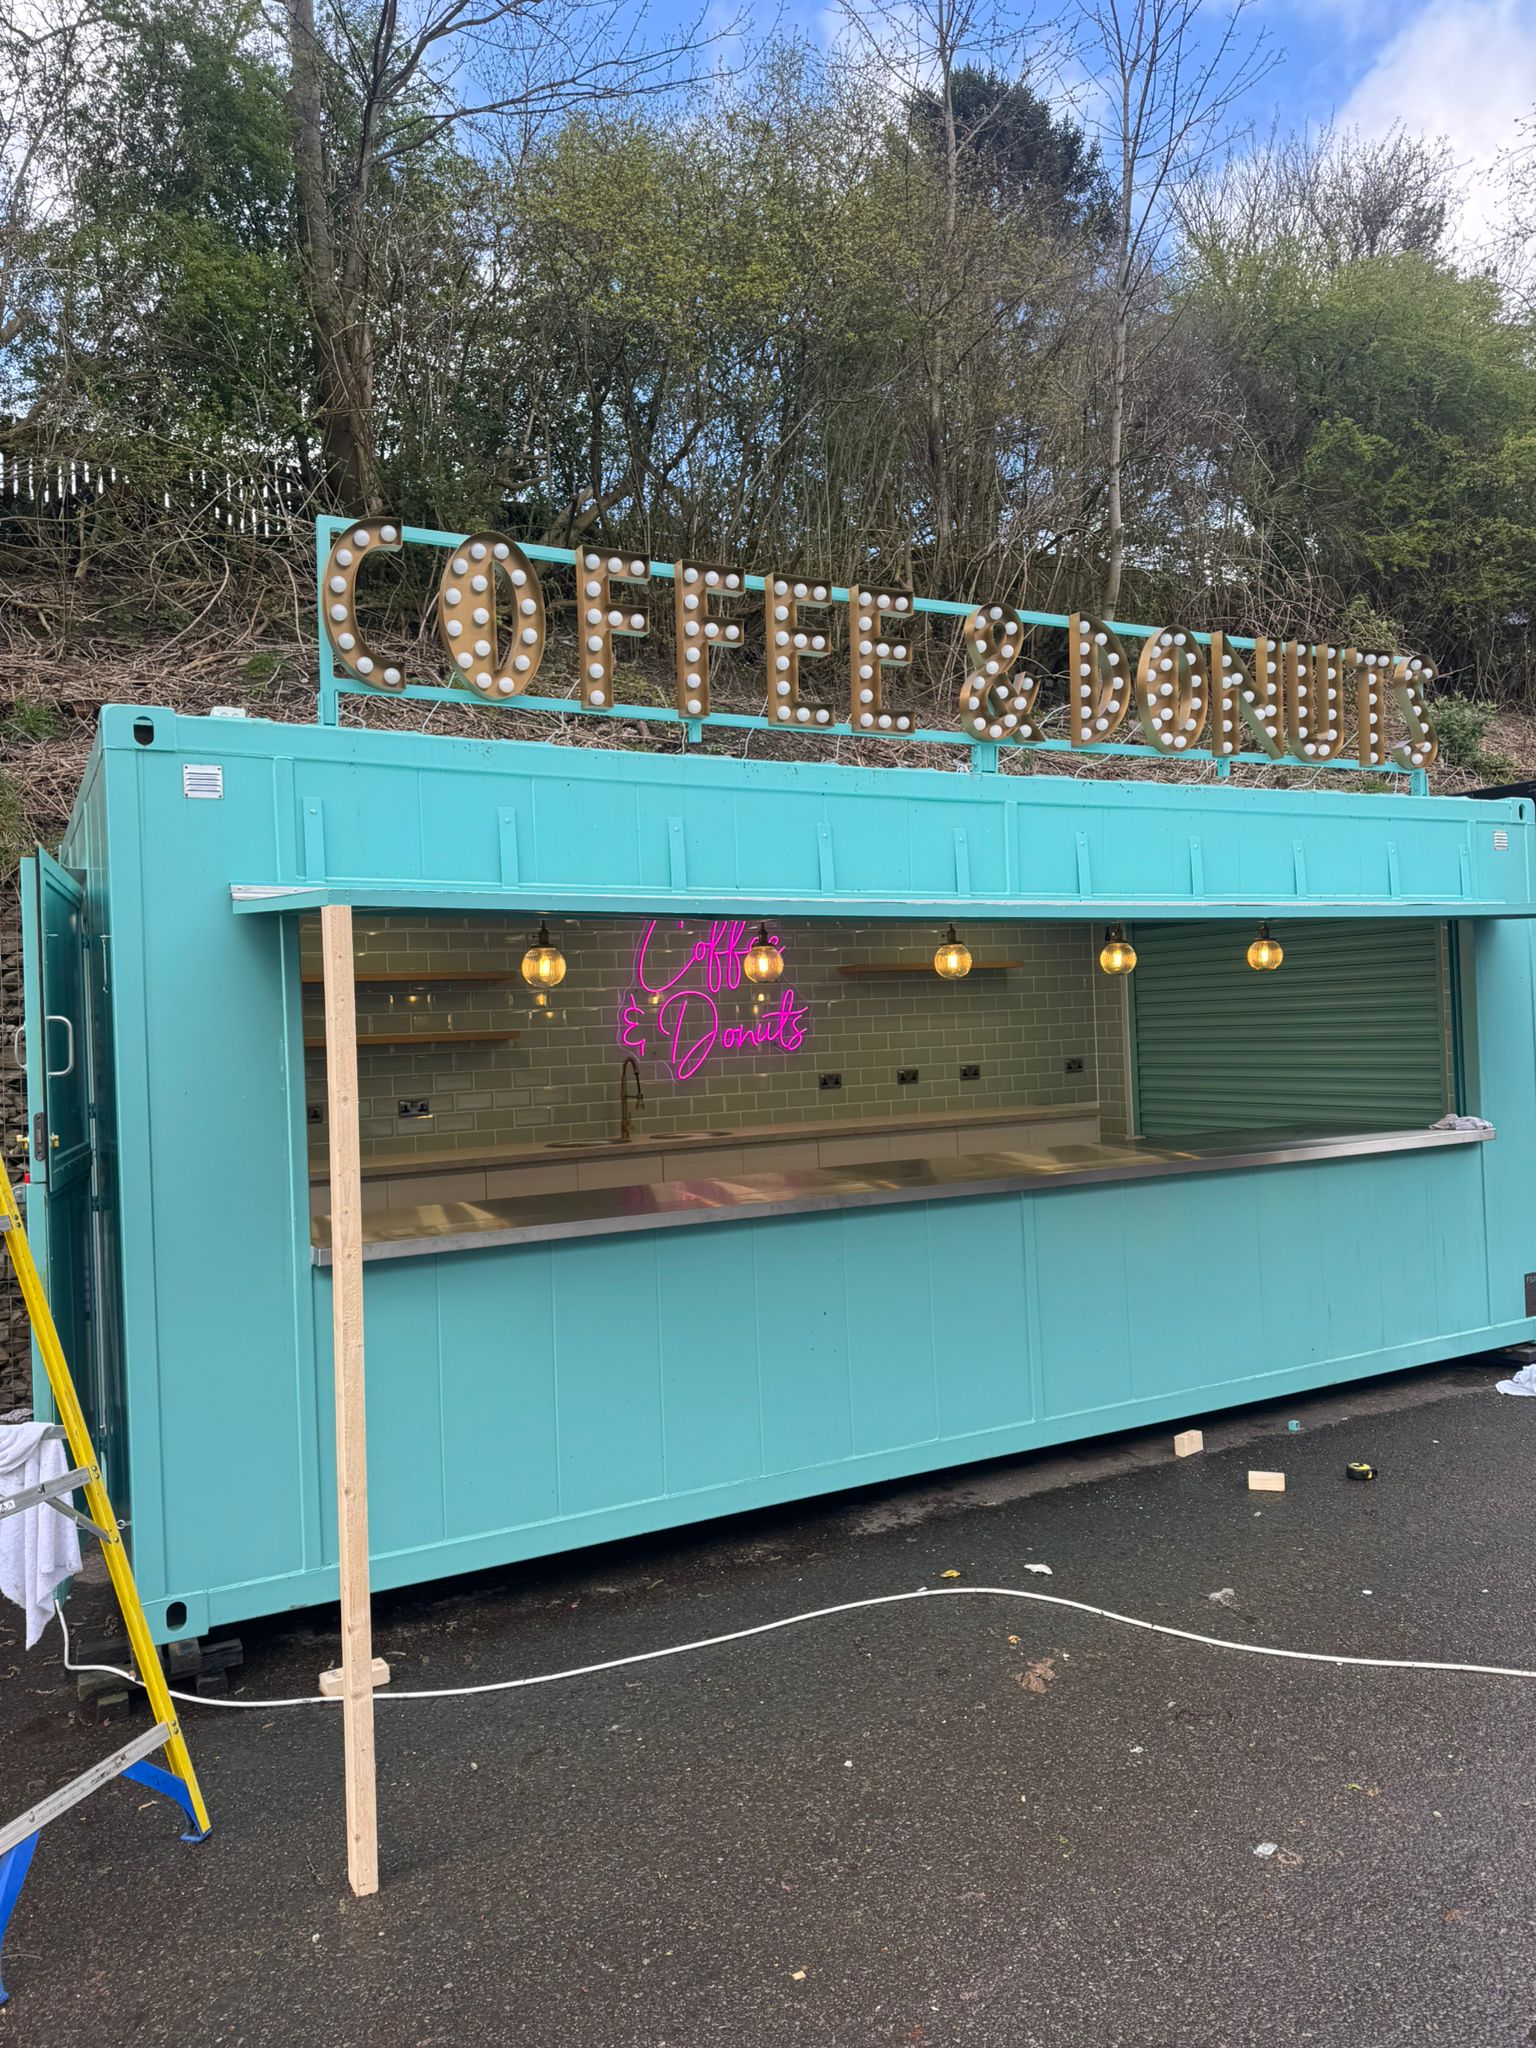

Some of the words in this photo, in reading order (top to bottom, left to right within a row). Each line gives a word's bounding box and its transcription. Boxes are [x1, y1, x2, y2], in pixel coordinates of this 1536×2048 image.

[323, 516, 917, 735] COFFEE
[959, 602, 1047, 744] &
[1068, 611, 1439, 770] DONUTS
[622, 993, 646, 1056] &
[658, 989, 809, 1080] Donuts
